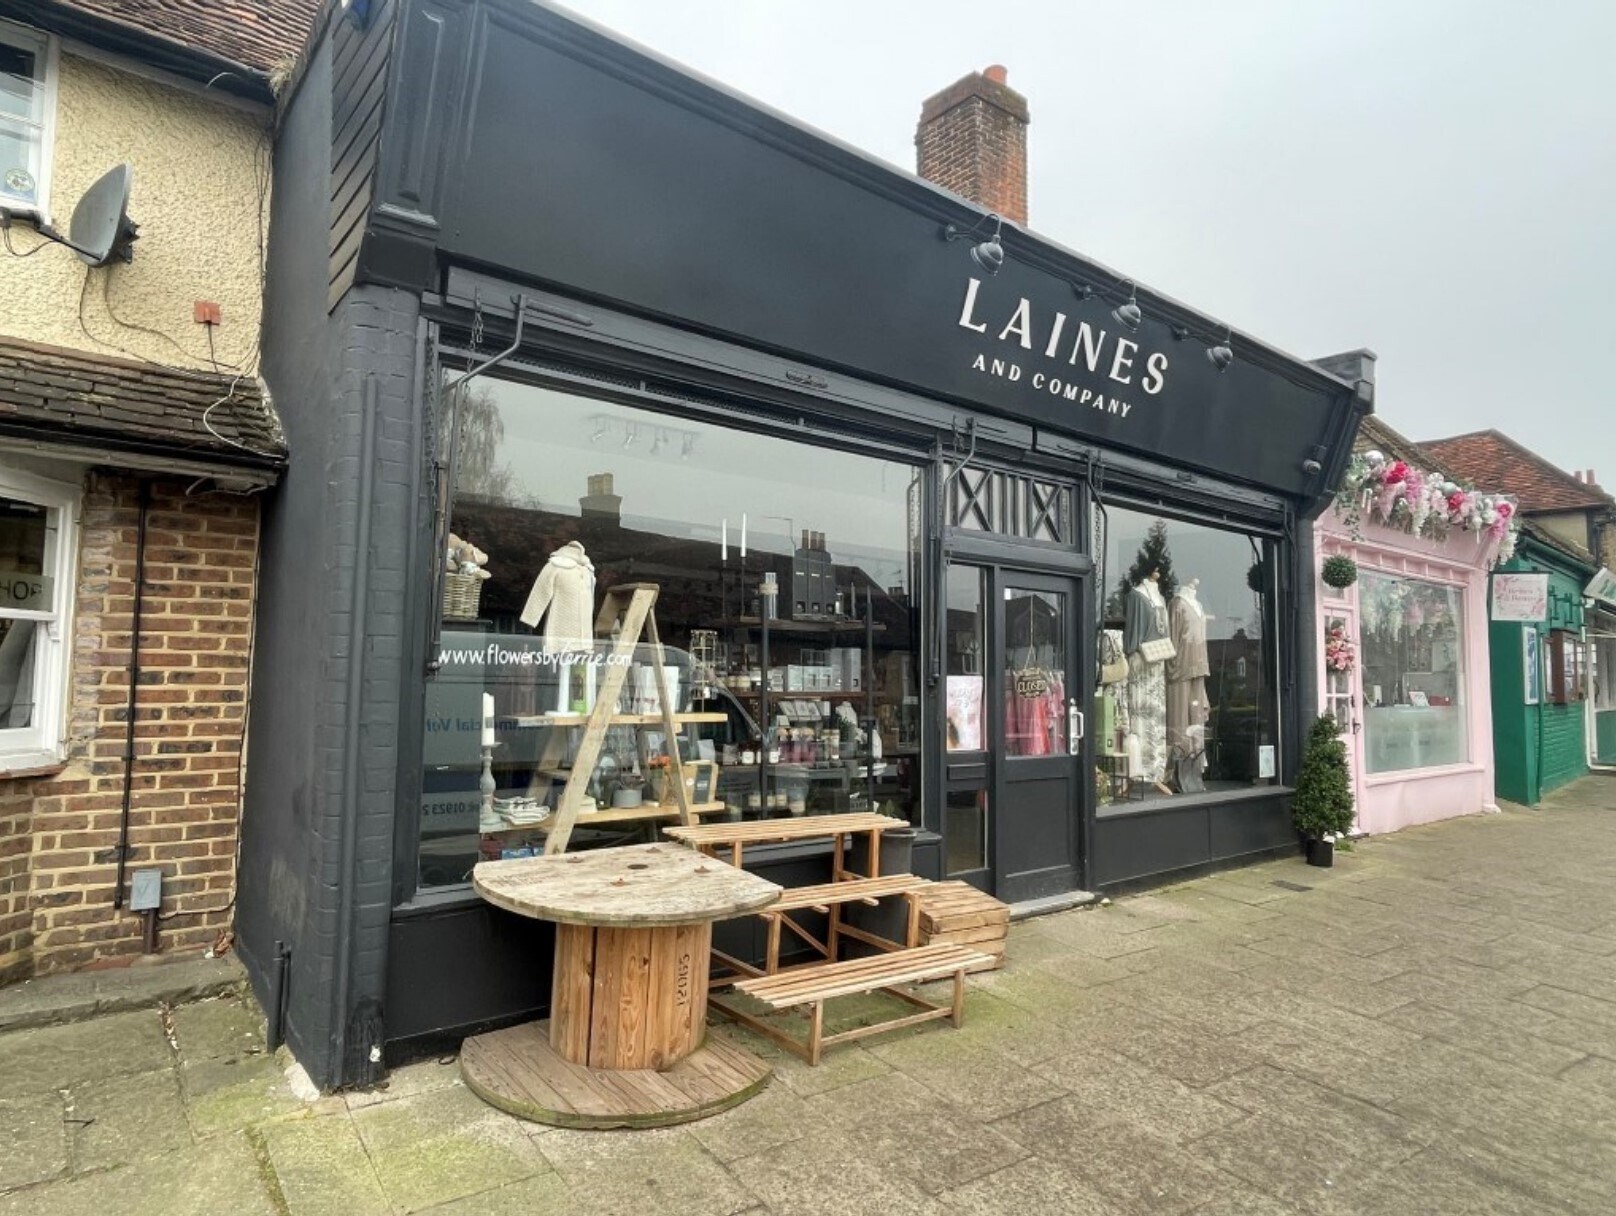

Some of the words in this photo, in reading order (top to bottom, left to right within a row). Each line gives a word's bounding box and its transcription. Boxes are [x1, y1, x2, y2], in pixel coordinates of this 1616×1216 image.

[958, 277, 1168, 395] LAINES
[972, 353, 1021, 382] AND
[1032, 373, 1132, 418] COMPANY
